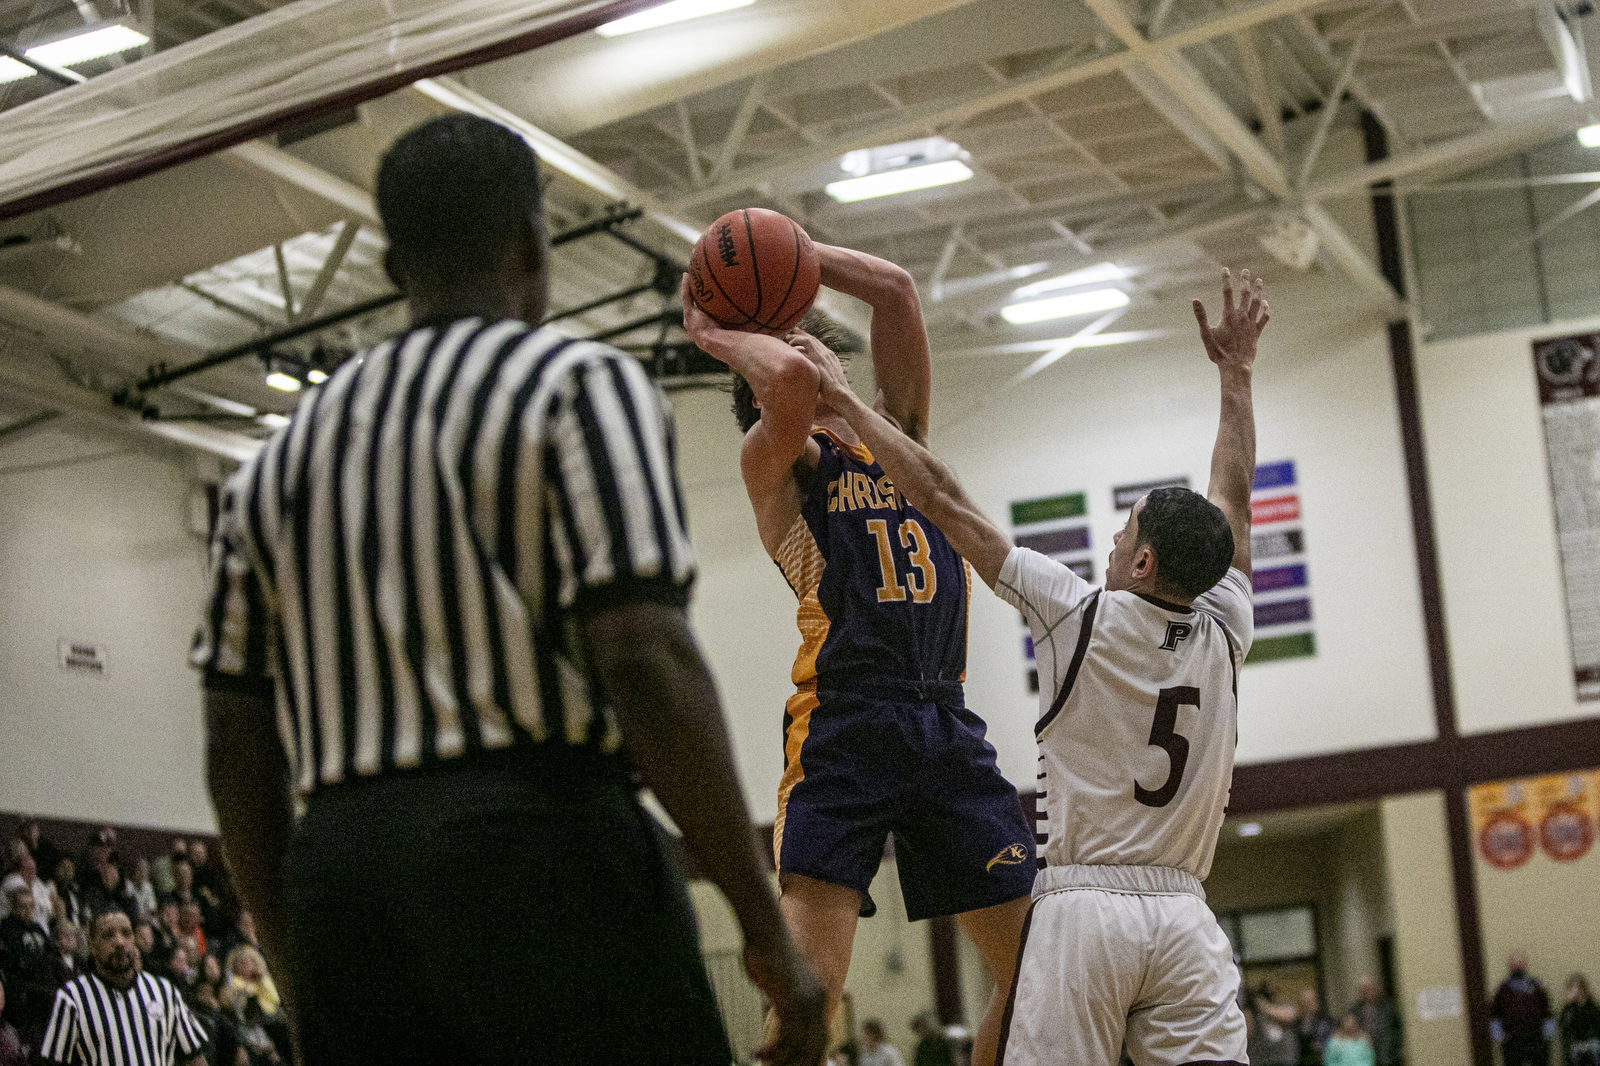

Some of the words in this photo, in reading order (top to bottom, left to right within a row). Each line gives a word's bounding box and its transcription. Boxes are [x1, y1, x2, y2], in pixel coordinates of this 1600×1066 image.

[827, 471, 913, 513] CHRIS
[866, 518, 937, 604] 13
[1158, 620, 1192, 652] P
[1134, 685, 1200, 808] 5
